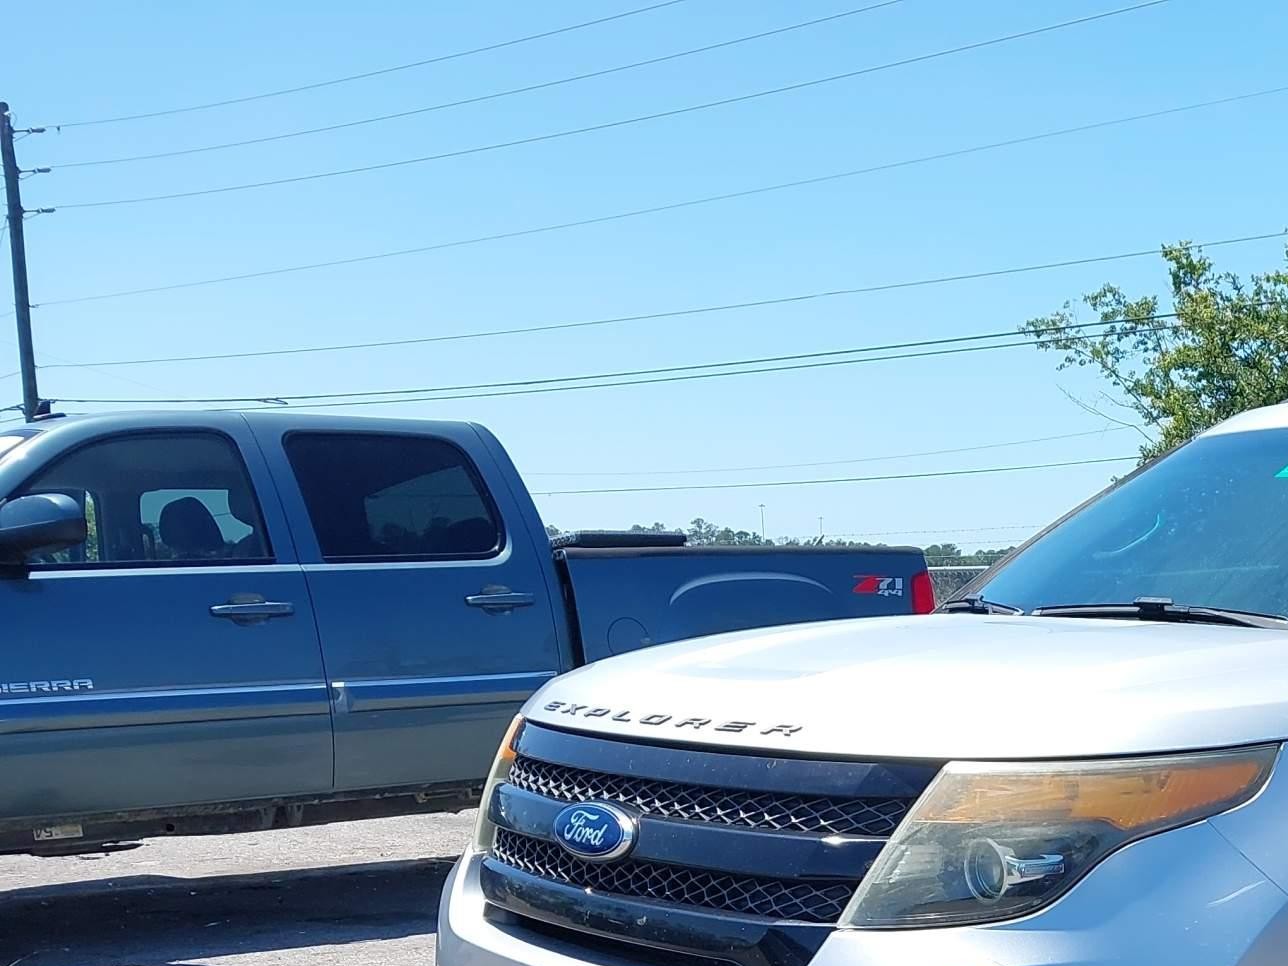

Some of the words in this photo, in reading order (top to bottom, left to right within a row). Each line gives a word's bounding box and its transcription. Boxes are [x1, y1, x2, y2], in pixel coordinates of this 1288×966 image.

[0, 679, 94, 693] IERRA
[543, 701, 803, 737] EXPLORER
[564, 810, 608, 846] Ford
